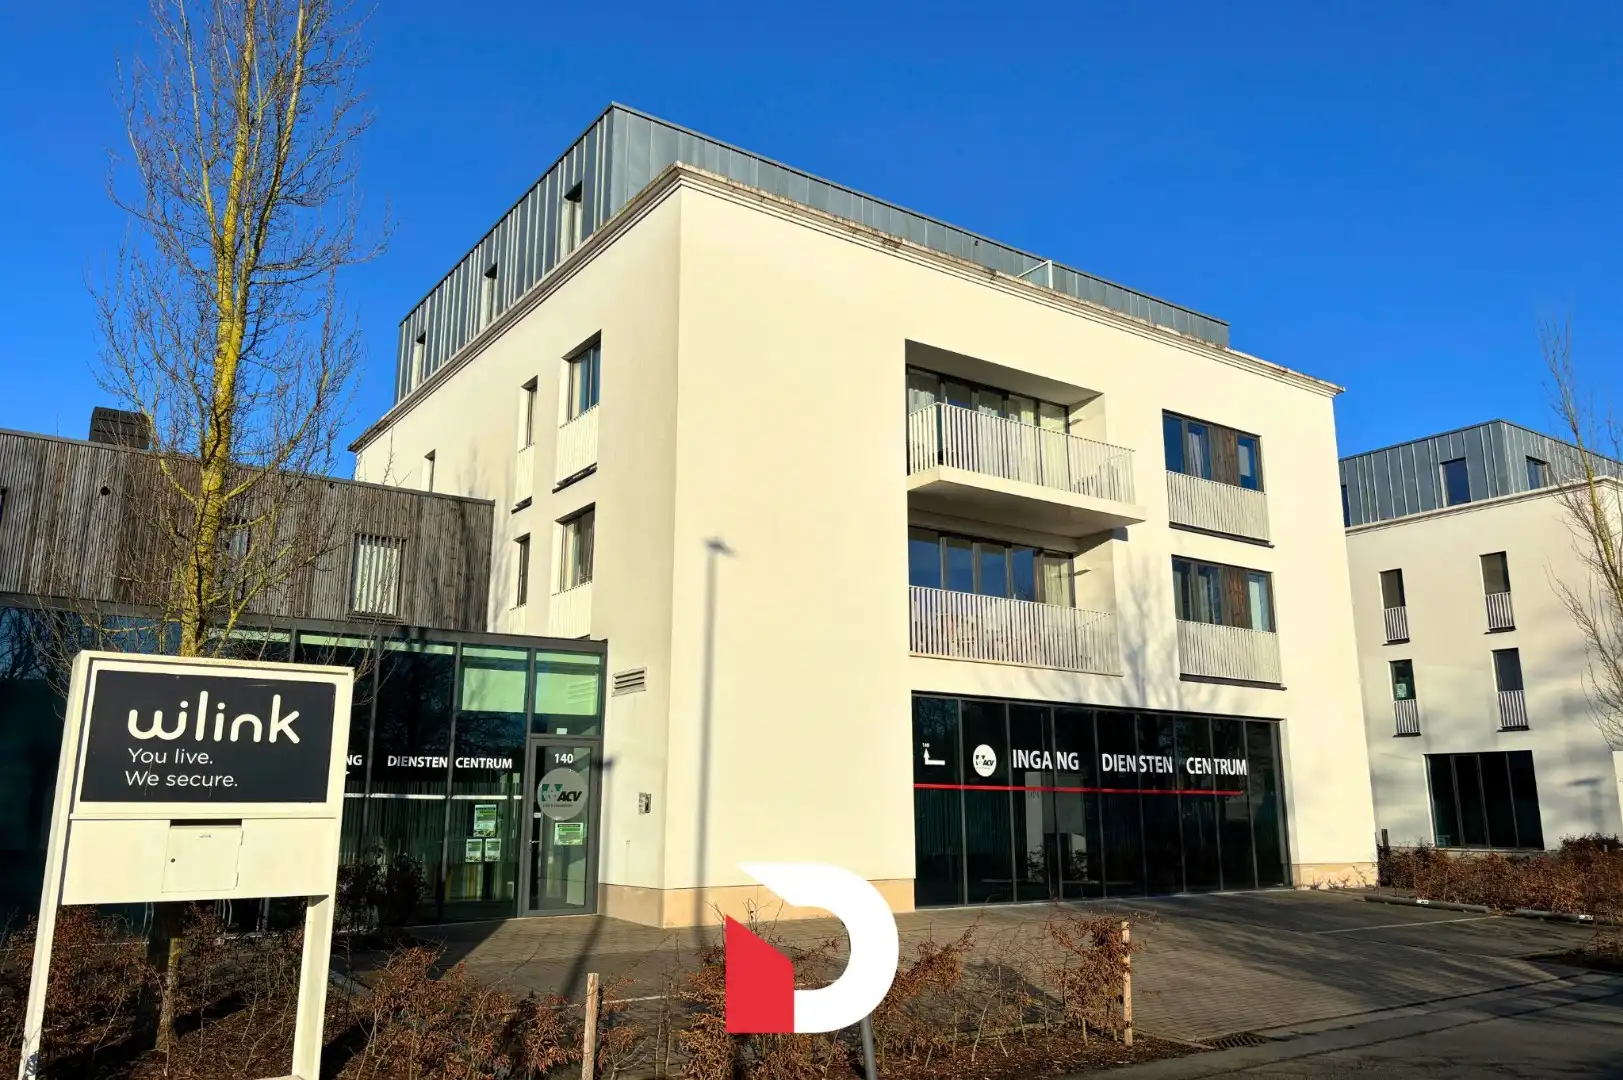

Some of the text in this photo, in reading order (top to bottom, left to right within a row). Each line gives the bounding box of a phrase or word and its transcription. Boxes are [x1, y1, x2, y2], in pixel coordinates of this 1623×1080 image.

[127, 690, 300, 744] wilink
[128, 747, 214, 765] You live.
[387, 755, 448, 768] DIENSTEN
[455, 756, 512, 769] CENTRUM
[554, 752, 574, 764] 140
[1013, 749, 1247, 776] INGANG DIENSTEN CENTRUM
[125, 770, 238, 788] We secure.
[557, 790, 583, 802] ACV
